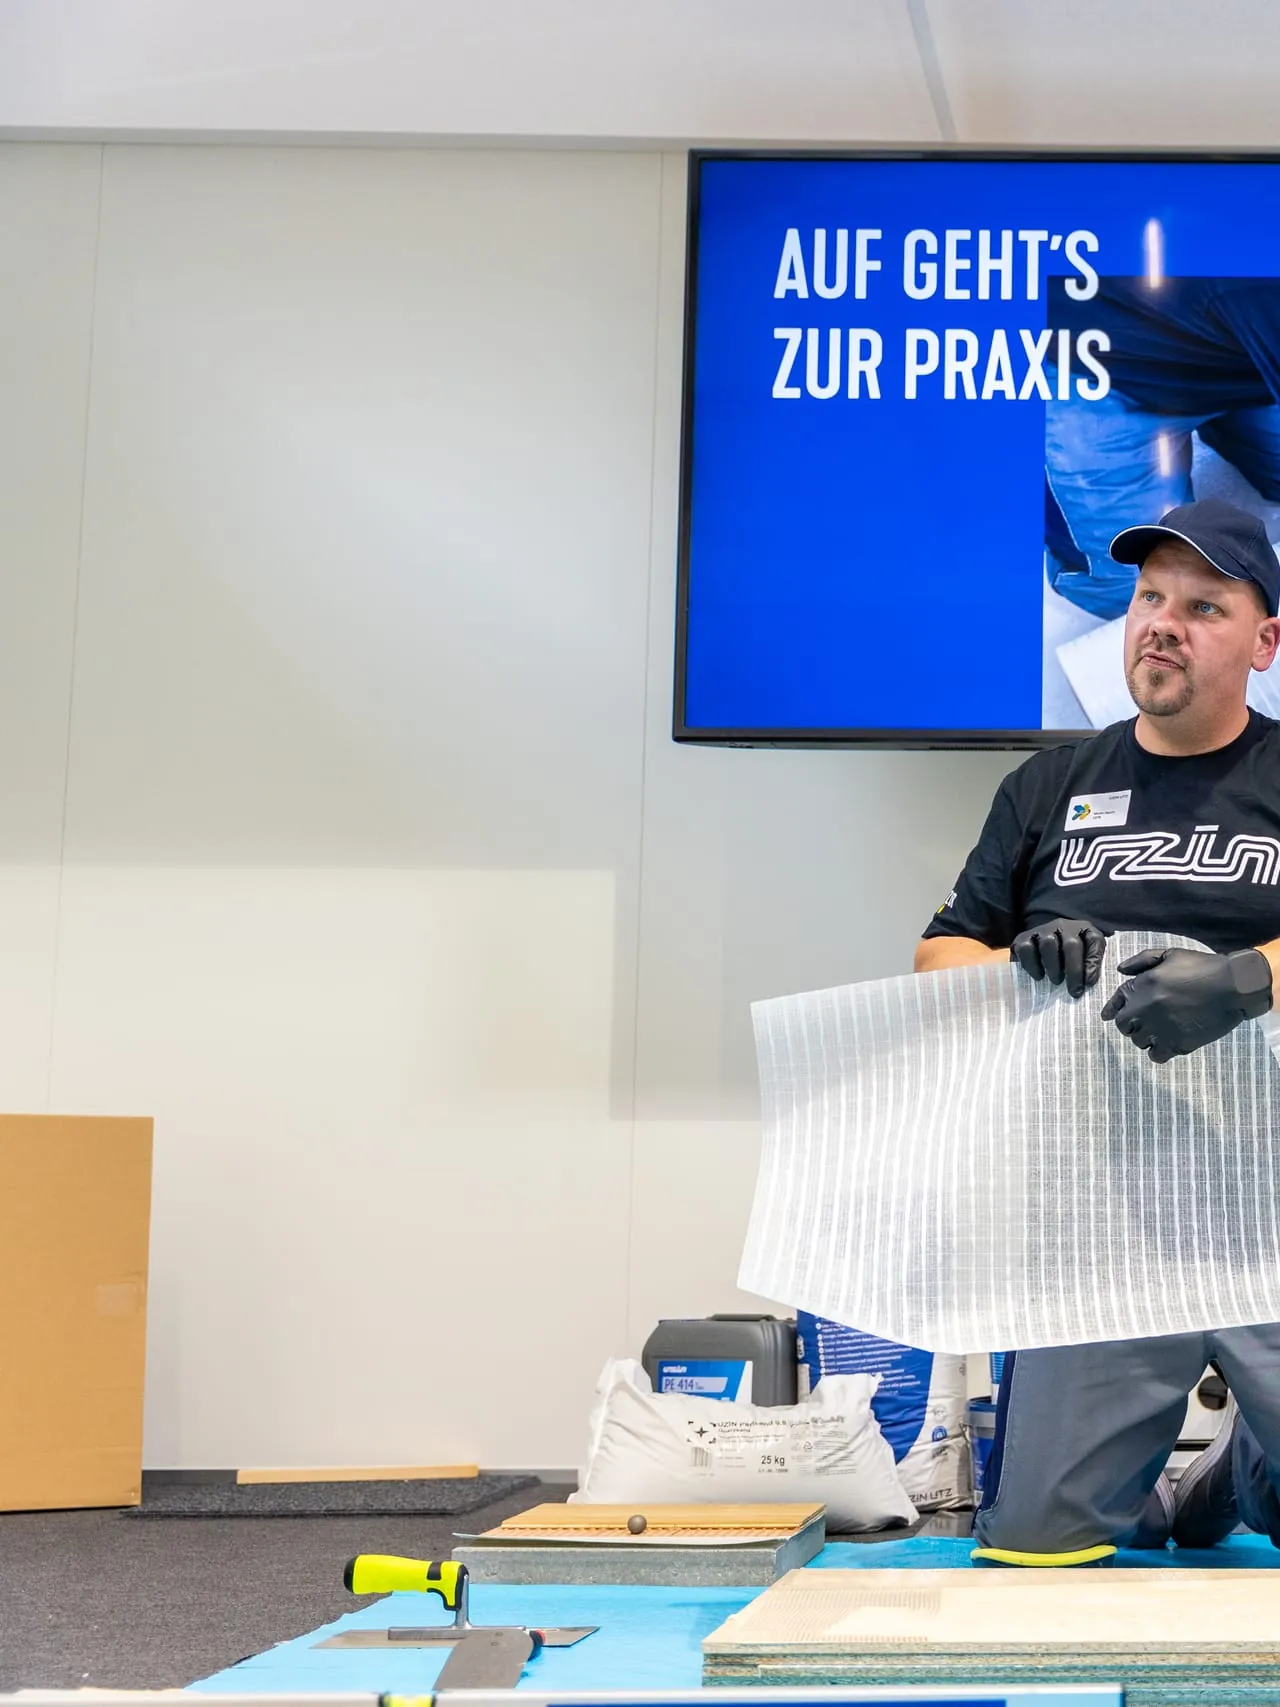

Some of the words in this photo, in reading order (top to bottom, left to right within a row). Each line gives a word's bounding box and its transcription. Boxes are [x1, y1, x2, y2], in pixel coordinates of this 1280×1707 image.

[774, 228, 883, 300] AUF
[903, 229, 1099, 301] GEHT'S
[772, 327, 883, 399] ZUR
[905, 328, 1111, 401] PRAXIS
[664, 1378, 674, 1390] PE
[677, 1379, 693, 1390] 414
[761, 1455, 772, 1465] 25
[774, 1455, 785, 1467] kg
[909, 1492, 928, 1503] ZIN
[929, 1487, 953, 1501] UTZ
